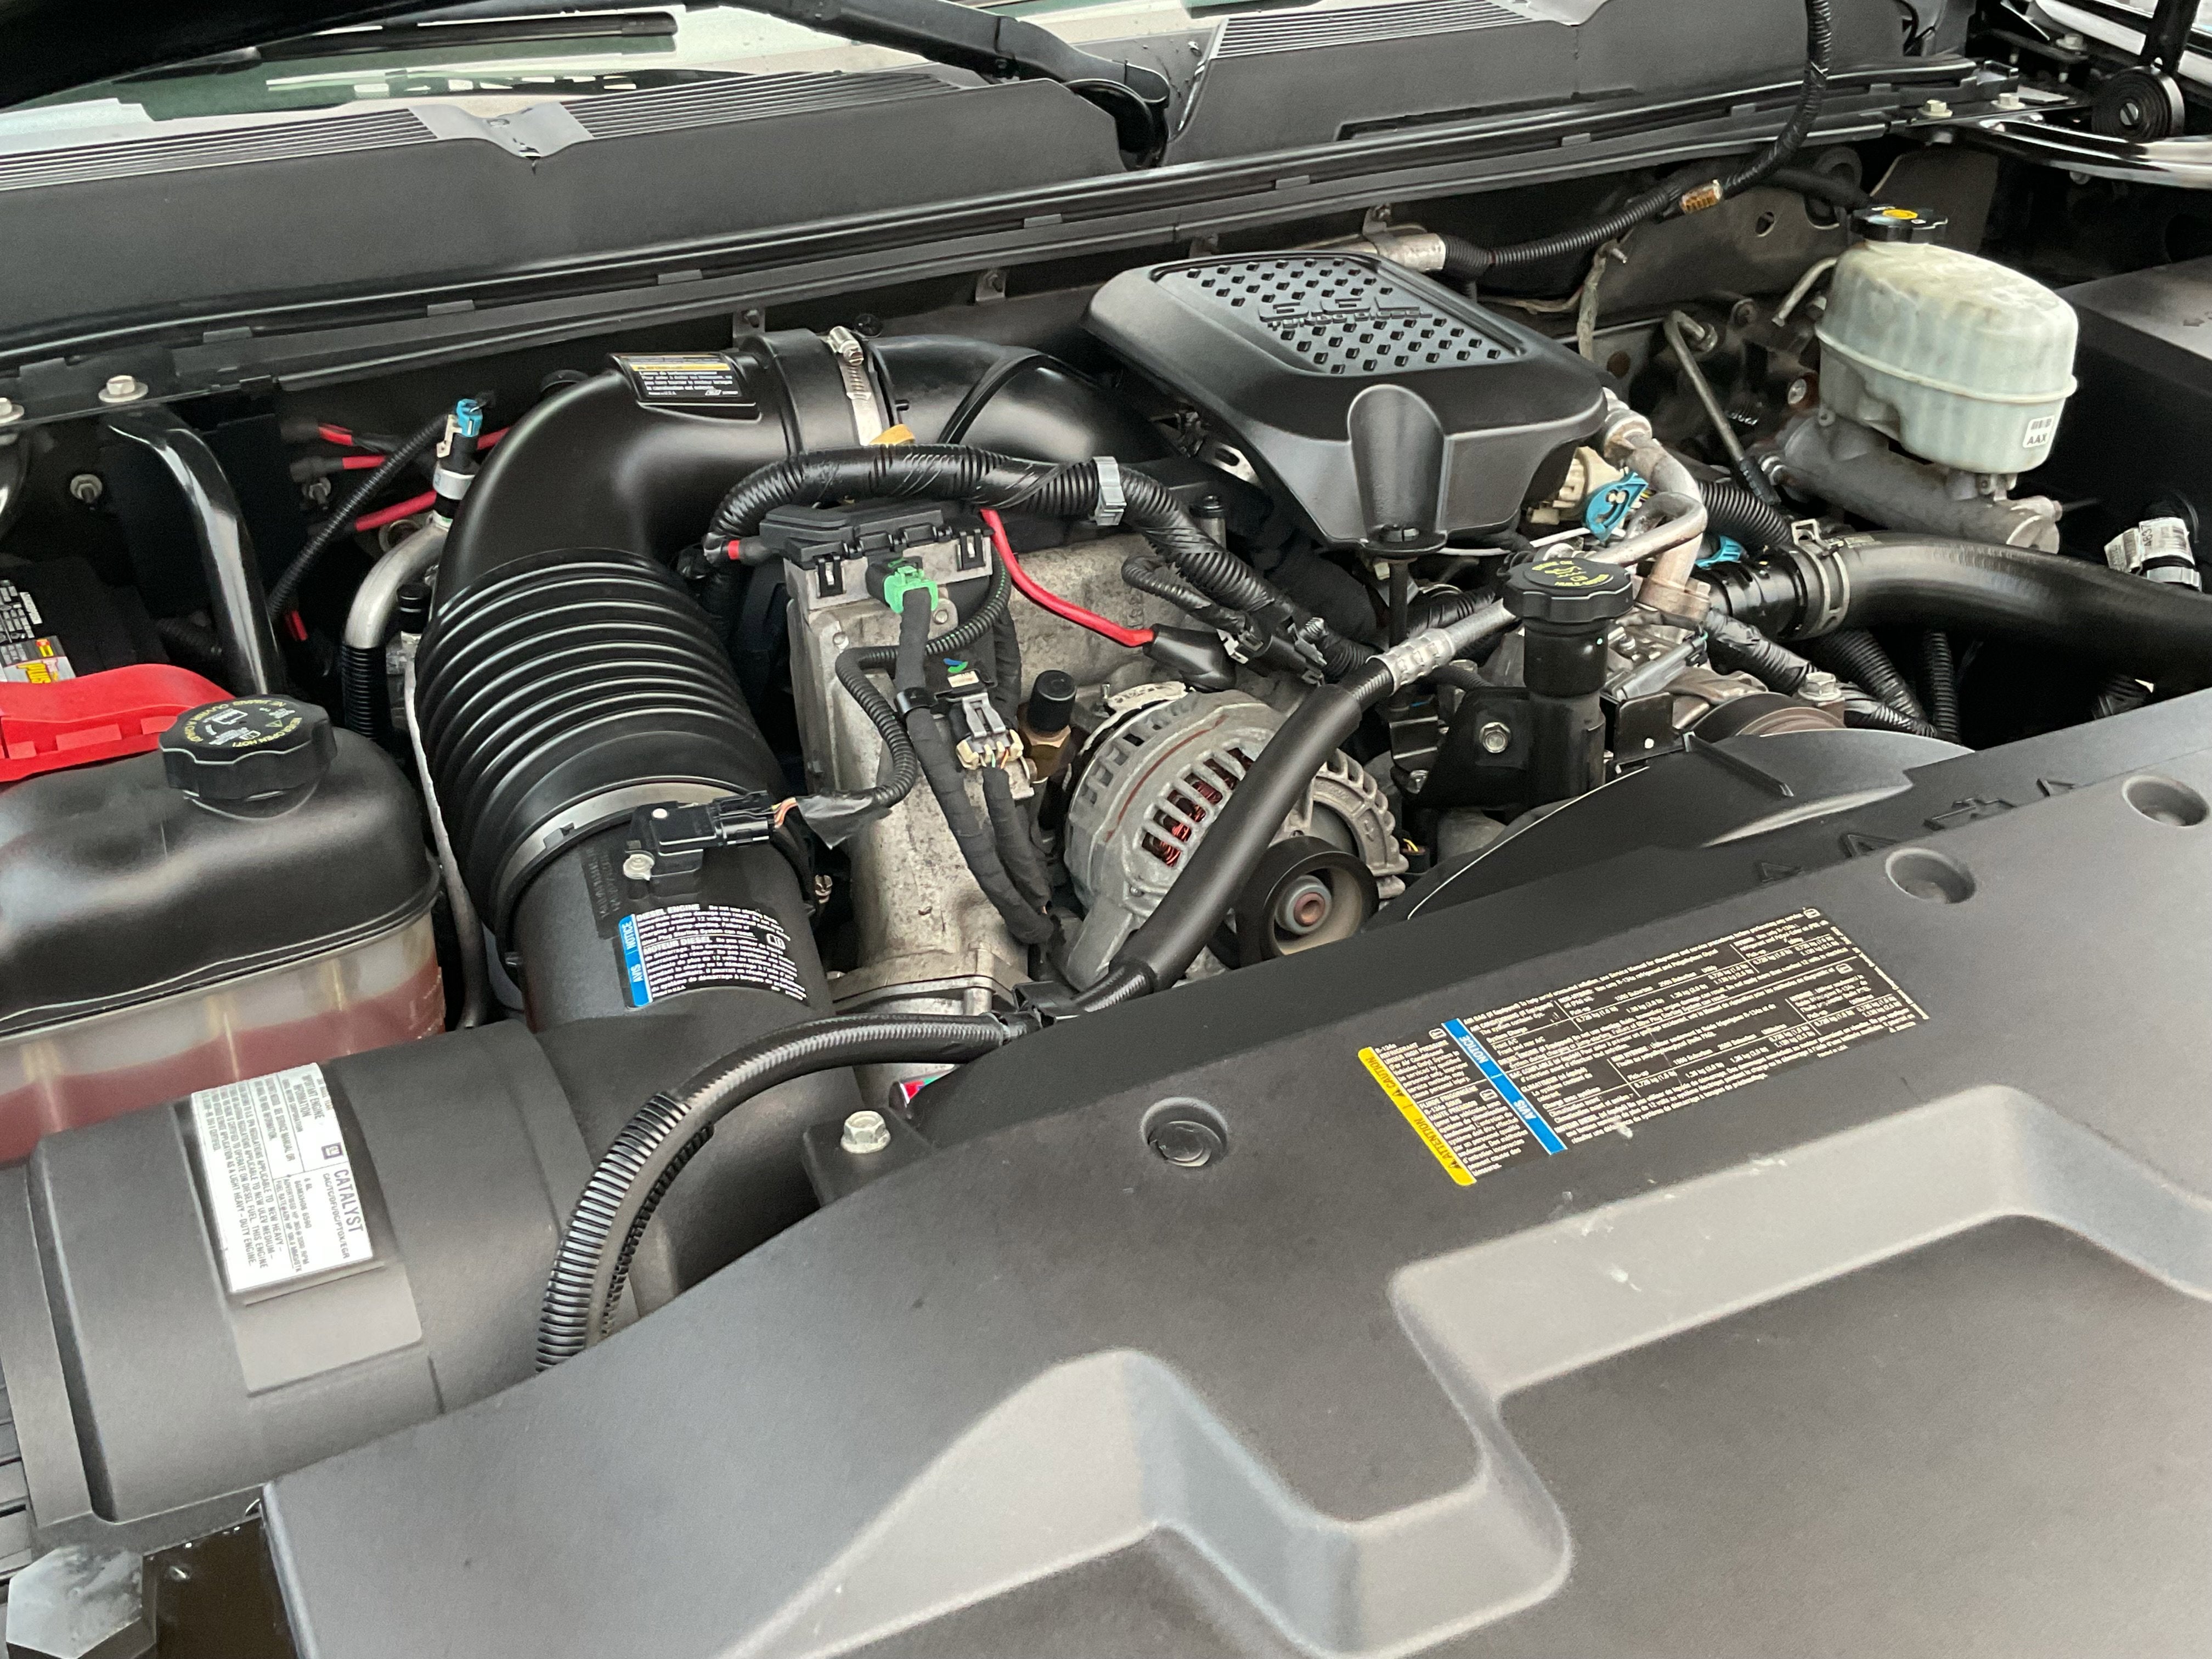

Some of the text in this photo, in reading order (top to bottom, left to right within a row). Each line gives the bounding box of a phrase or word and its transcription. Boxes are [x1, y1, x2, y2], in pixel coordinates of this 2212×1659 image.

[2027, 433, 2047, 445] AAX
[637, 909, 666, 921] DIESEL
[668, 904, 699, 914] ENGINE
[622, 921, 636, 950] NOTICE
[644, 940, 679, 955] MOTEUR
[681, 936, 712, 946] DIESEL
[631, 963, 644, 983] AVIS
[1462, 1037, 1488, 1063] NOTICE
[1365, 1057, 1396, 1088] CAUTION
[310, 1097, 325, 1119] ENGINE
[1514, 1099, 1536, 1120] AVIS
[281, 1132, 292, 1153] MANUAL
[1414, 1118, 1452, 1159] ATTENTION
[234, 1149, 246, 1172] OPERATE
[244, 1150, 258, 1181] APPLICABLE
[229, 1174, 240, 1190] LIGHT
[239, 1173, 248, 1182] ON
[252, 1181, 261, 1190] TO
[257, 1160, 272, 1193] APPLICABLE
[275, 1180, 284, 1193] FUEL
[234, 1192, 245, 1211] HEAVY
[241, 1183, 253, 1204] DIESEL
[254, 1191, 264, 1205] NEW
[265, 1194, 274, 1203] TO
[334, 1169, 363, 1232] CATALYST
[257, 1207, 268, 1223] ULEV
[268, 1206, 278, 1221] NEW
[239, 1218, 251, 1235] DUTY
[252, 1225, 262, 1241] THIS
[272, 1223, 284, 1245] HEAVY
[291, 1211, 299, 1219] HP
[301, 1250, 309, 1265] RPM
[255, 1242, 268, 1268] ENGINE
